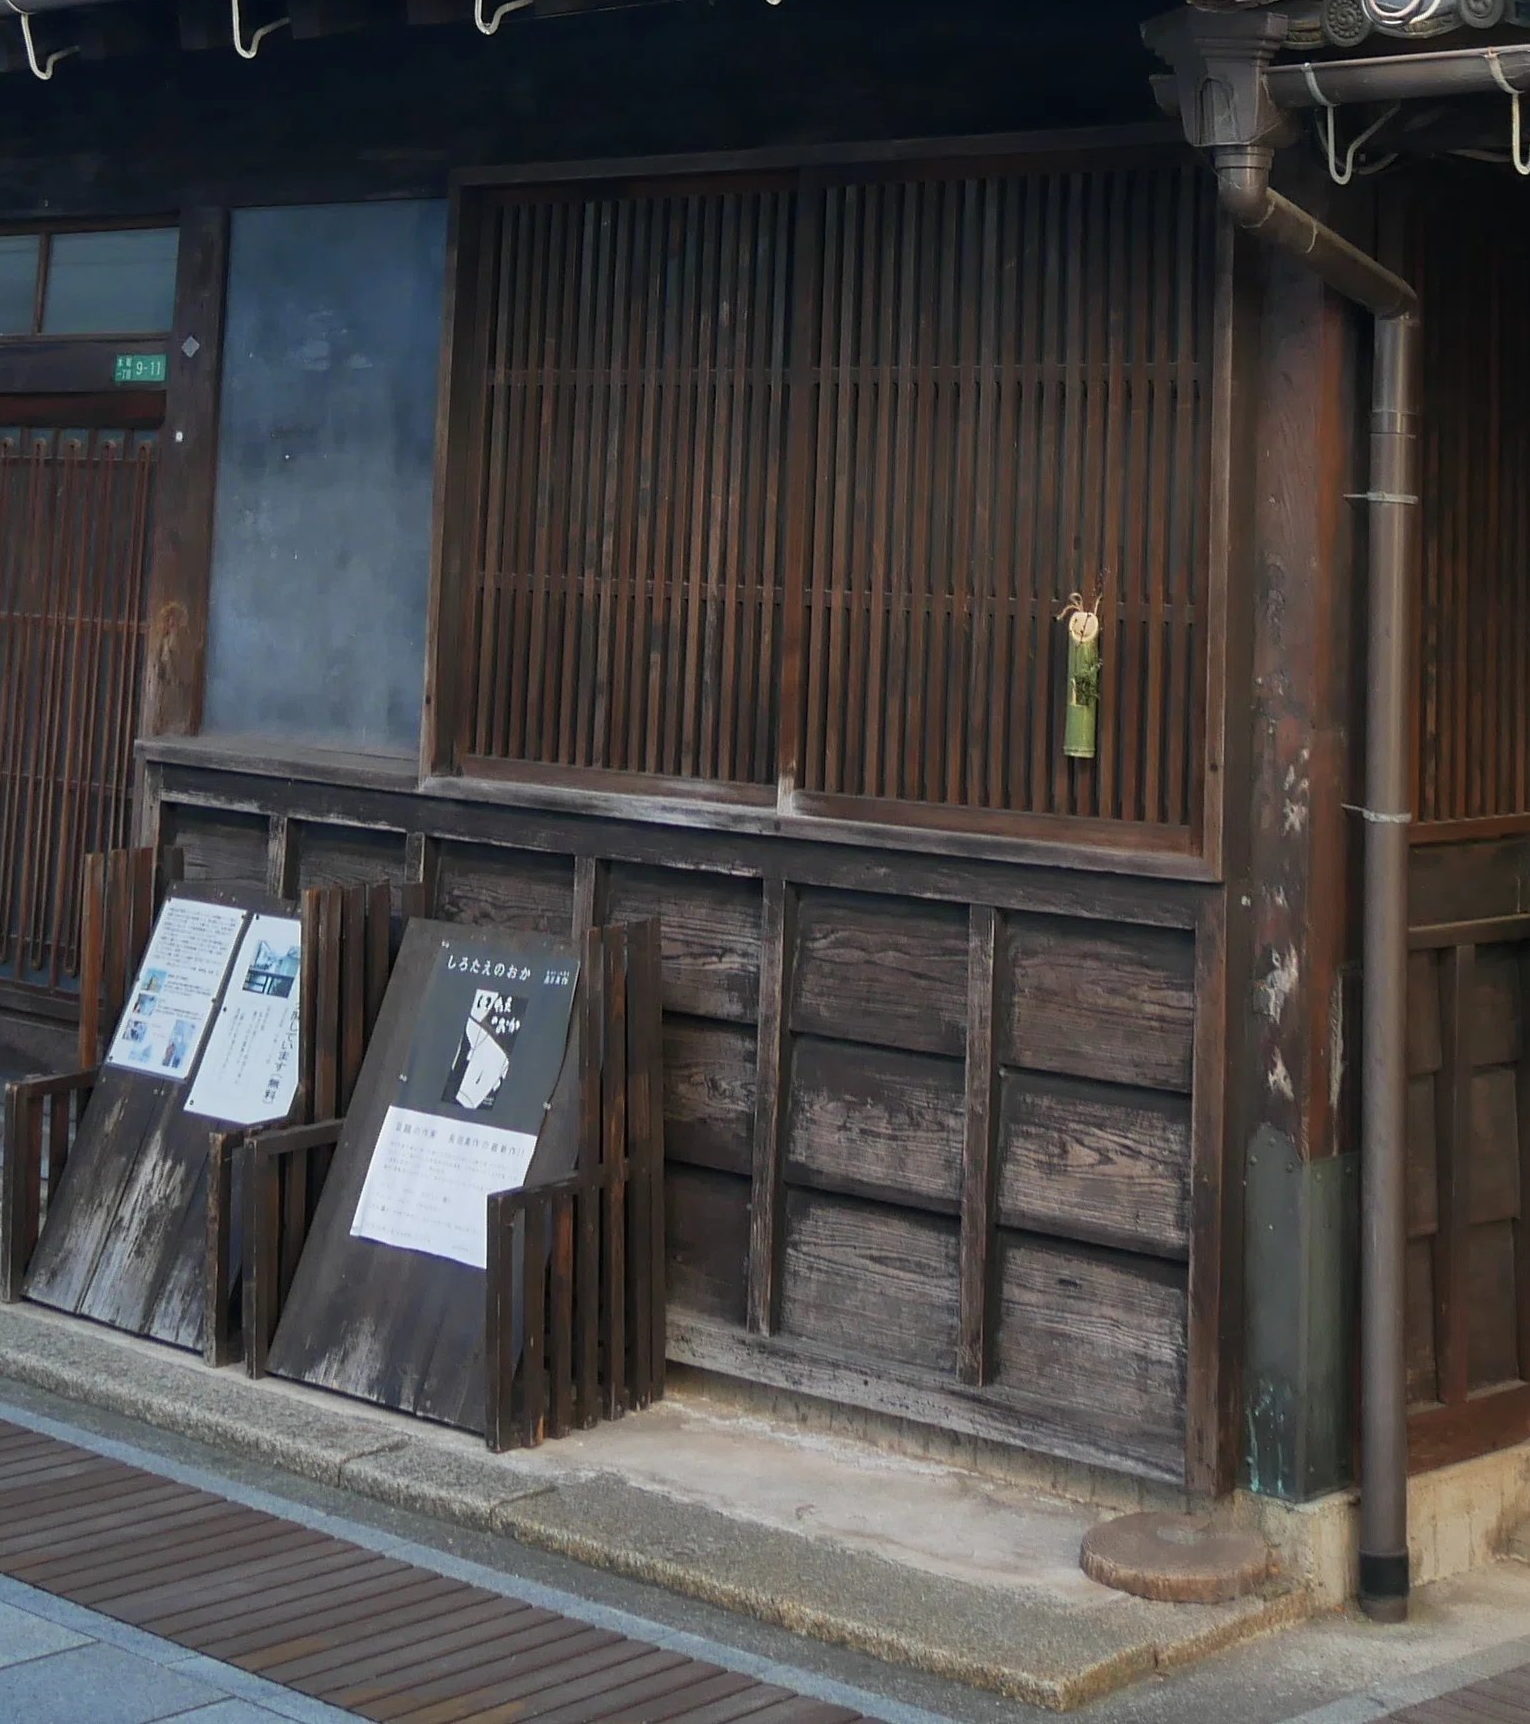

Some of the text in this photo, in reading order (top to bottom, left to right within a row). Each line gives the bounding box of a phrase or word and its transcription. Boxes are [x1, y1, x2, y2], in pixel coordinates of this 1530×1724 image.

[136, 361, 161, 376] 9-11
[448, 955, 531, 981] しろたえのおか
